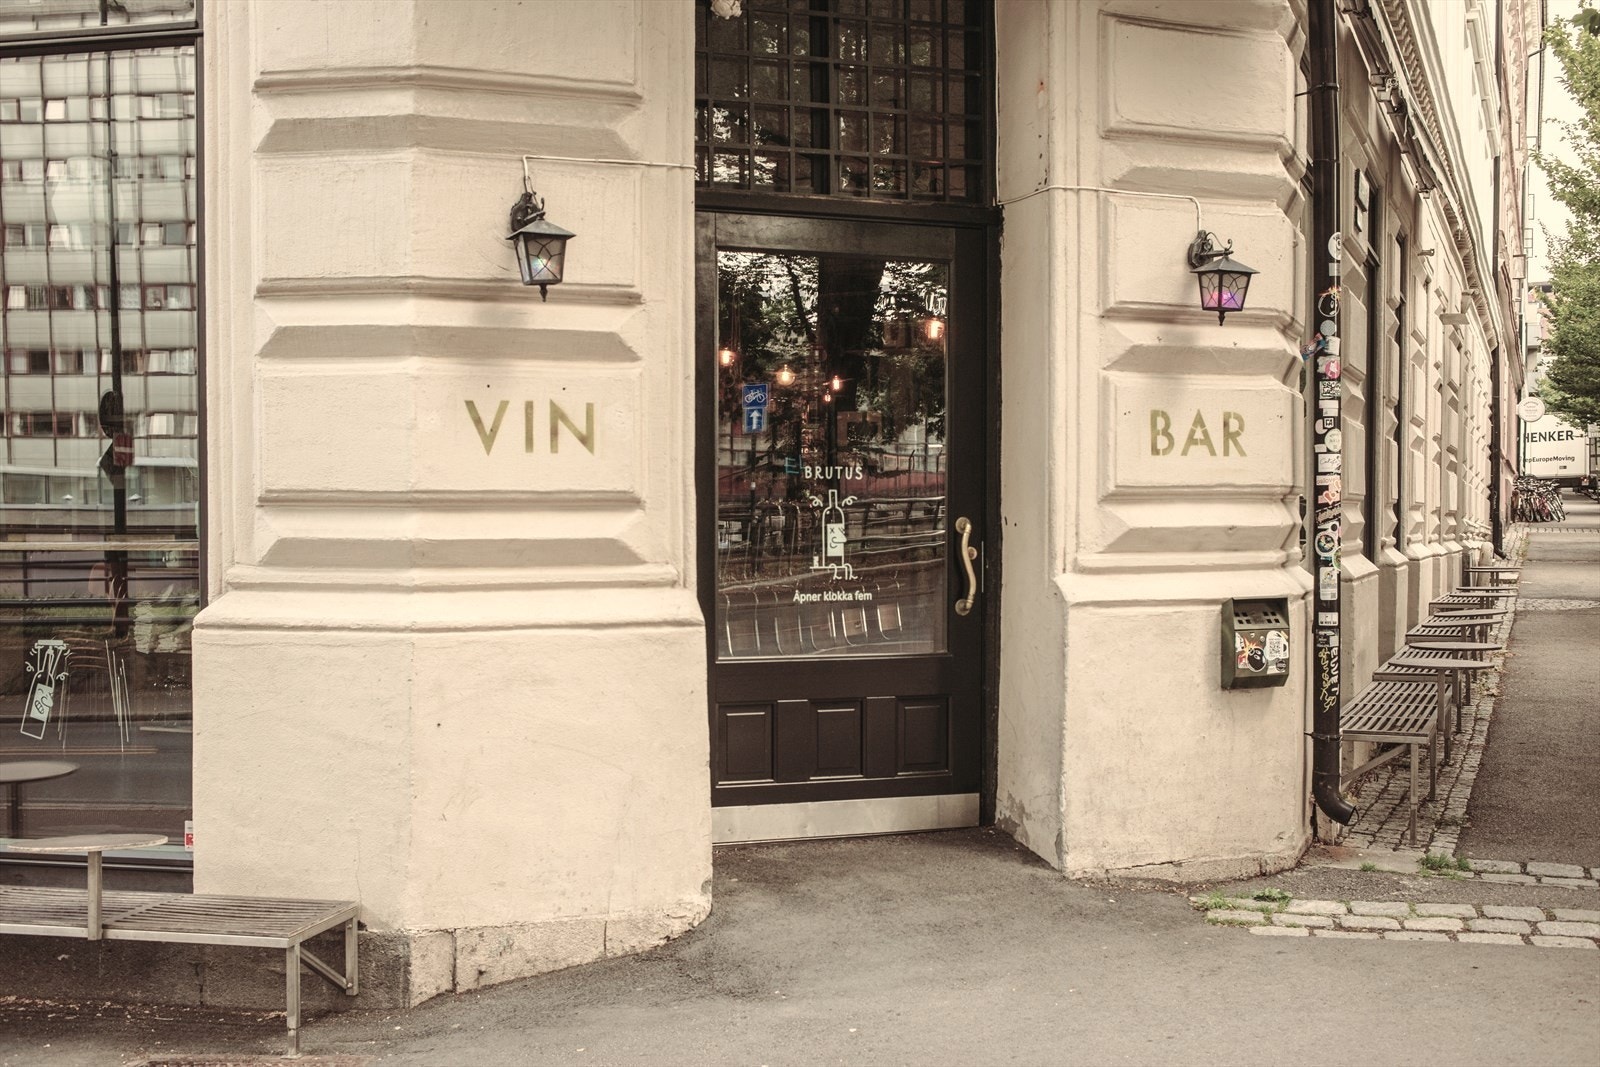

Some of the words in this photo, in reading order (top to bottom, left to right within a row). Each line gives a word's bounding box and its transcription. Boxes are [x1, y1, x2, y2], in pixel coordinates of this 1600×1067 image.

[464, 399, 594, 456] VIN
[1150, 409, 1247, 457] BAR
[804, 466, 863, 480] BRUTUS
[793, 590, 821, 604] Åpner
[824, 590, 853, 602] klokka
[855, 590, 873, 601] fem
